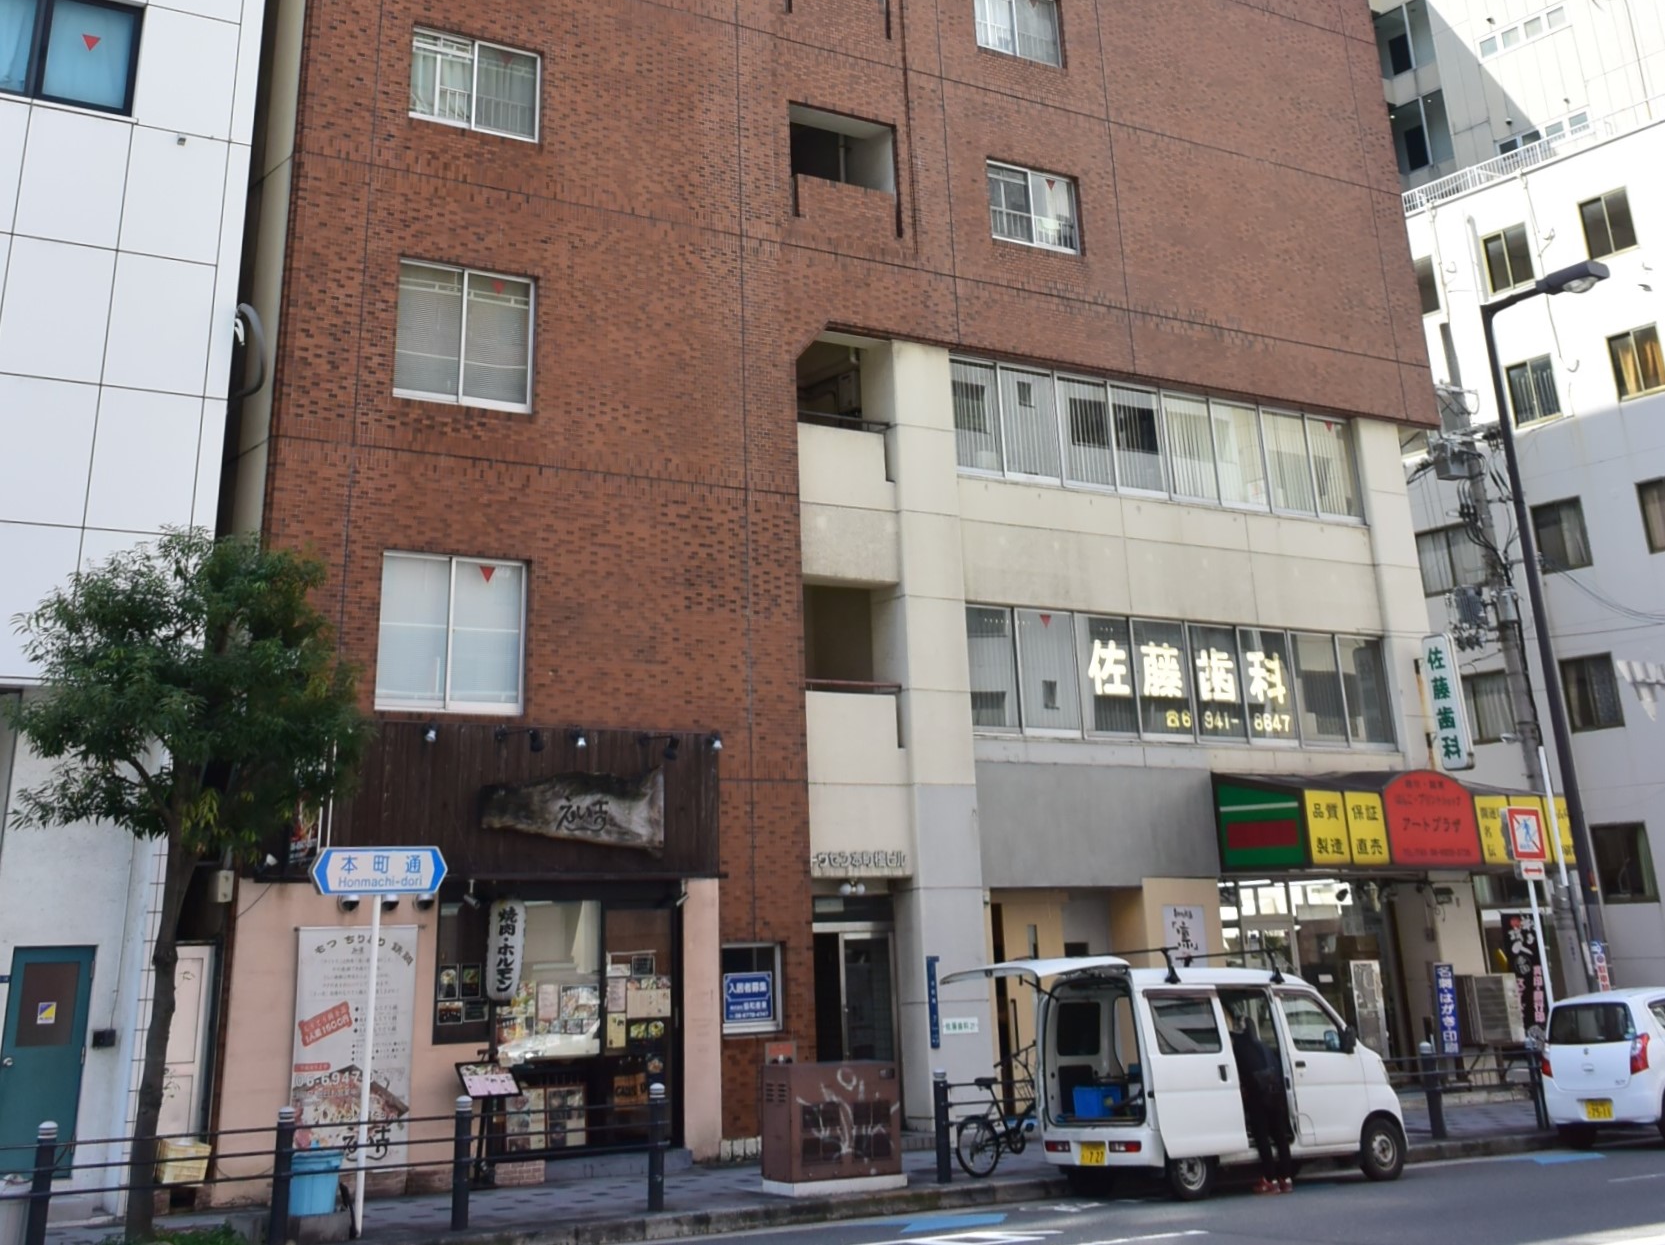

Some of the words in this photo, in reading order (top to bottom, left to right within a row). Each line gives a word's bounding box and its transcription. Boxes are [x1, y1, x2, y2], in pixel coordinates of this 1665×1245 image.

[1088, 638, 1286, 704] 佐藤歯科
[1427, 646, 1462, 760] 佐藤歯科
[1313, 803, 1339, 820] 品質
[1352, 804, 1379, 821] 保証
[1402, 817, 1461, 833] アートプラザ
[1317, 837, 1344, 855] 製造
[1356, 838, 1383, 855] 直売
[341, 855, 422, 874] 本町通
[338, 876, 422, 888] Honmachi-dori
[496, 906, 518, 992] 焼肉・ホルモン
[728, 981, 768, 994] 入居者募集
